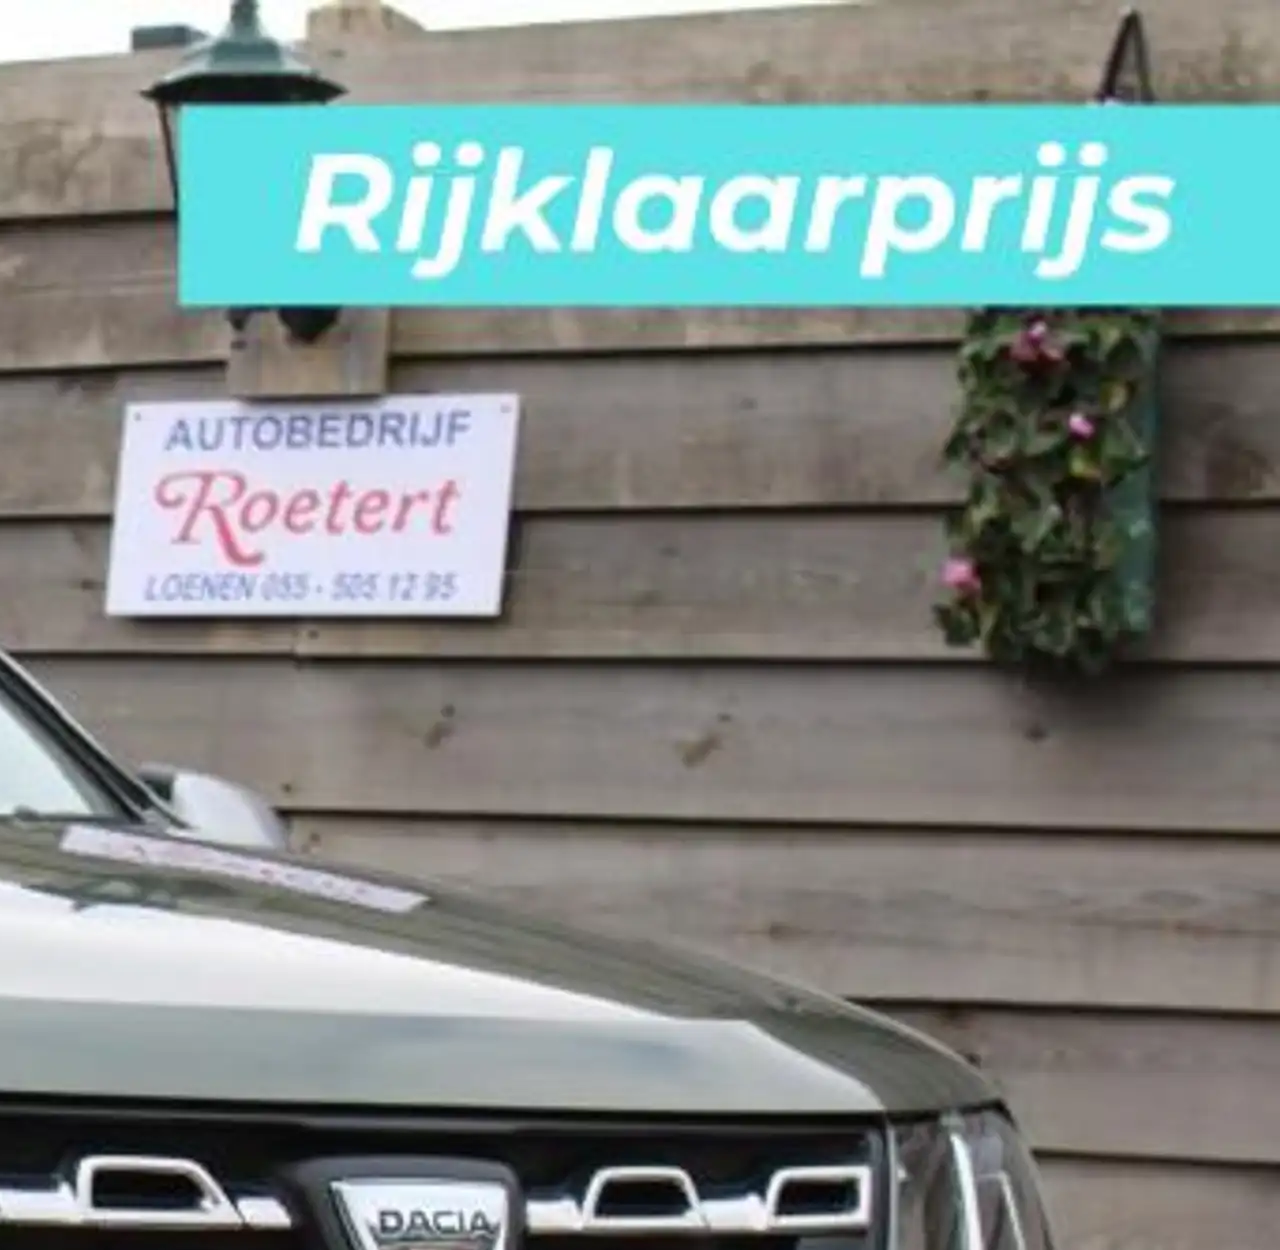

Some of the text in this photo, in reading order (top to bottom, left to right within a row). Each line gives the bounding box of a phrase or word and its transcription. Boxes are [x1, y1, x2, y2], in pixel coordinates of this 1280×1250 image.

[163, 409, 472, 452] AUTOBEDRIJF
[153, 469, 461, 567] Roetert
[144, 572, 255, 601] LOENEN
[379, 1210, 493, 1235] DACIA
